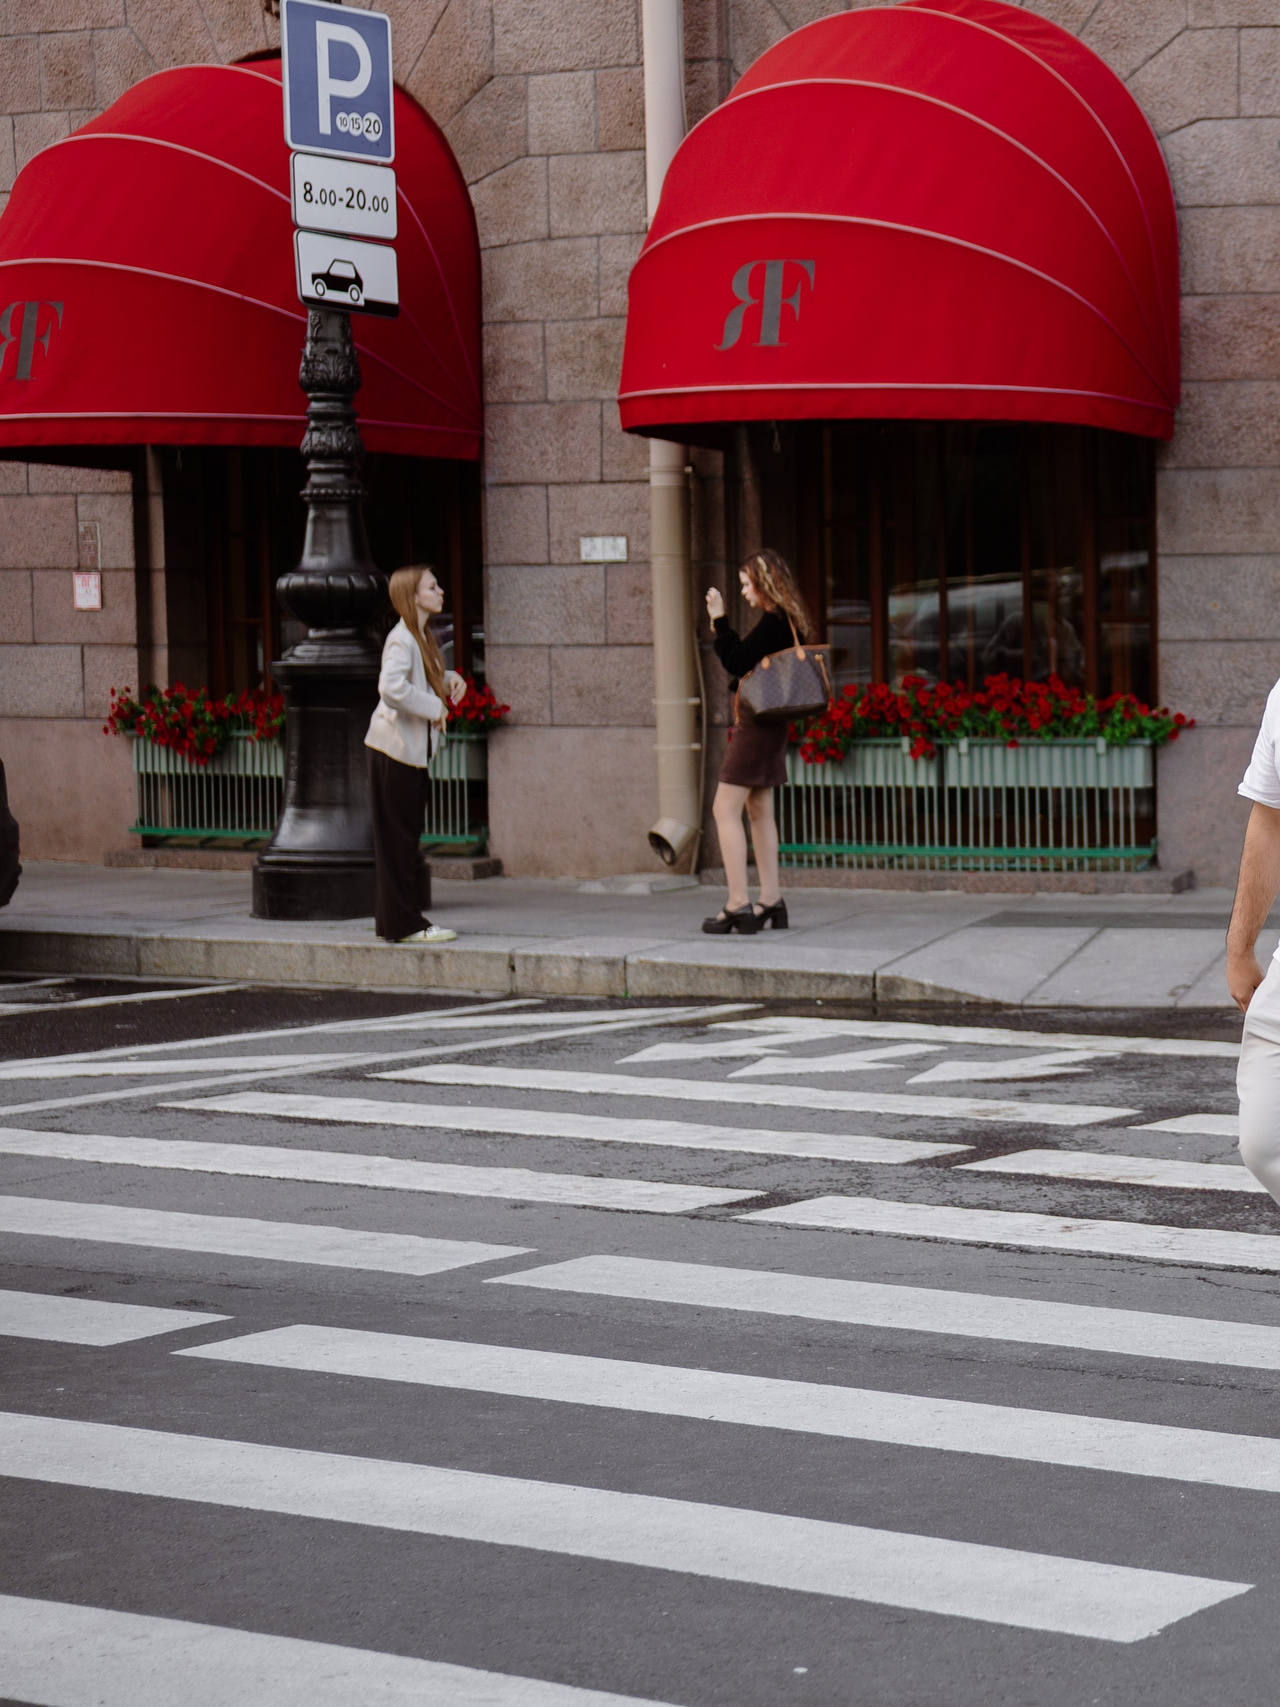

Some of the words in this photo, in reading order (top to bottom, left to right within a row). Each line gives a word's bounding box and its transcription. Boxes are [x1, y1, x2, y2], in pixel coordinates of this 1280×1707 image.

[315, 20, 372, 135] P
[339, 116, 348, 127] 10
[351, 117, 361, 130] 15
[365, 117, 381, 135] 20
[303, 181, 389, 213] 8.00-20.00
